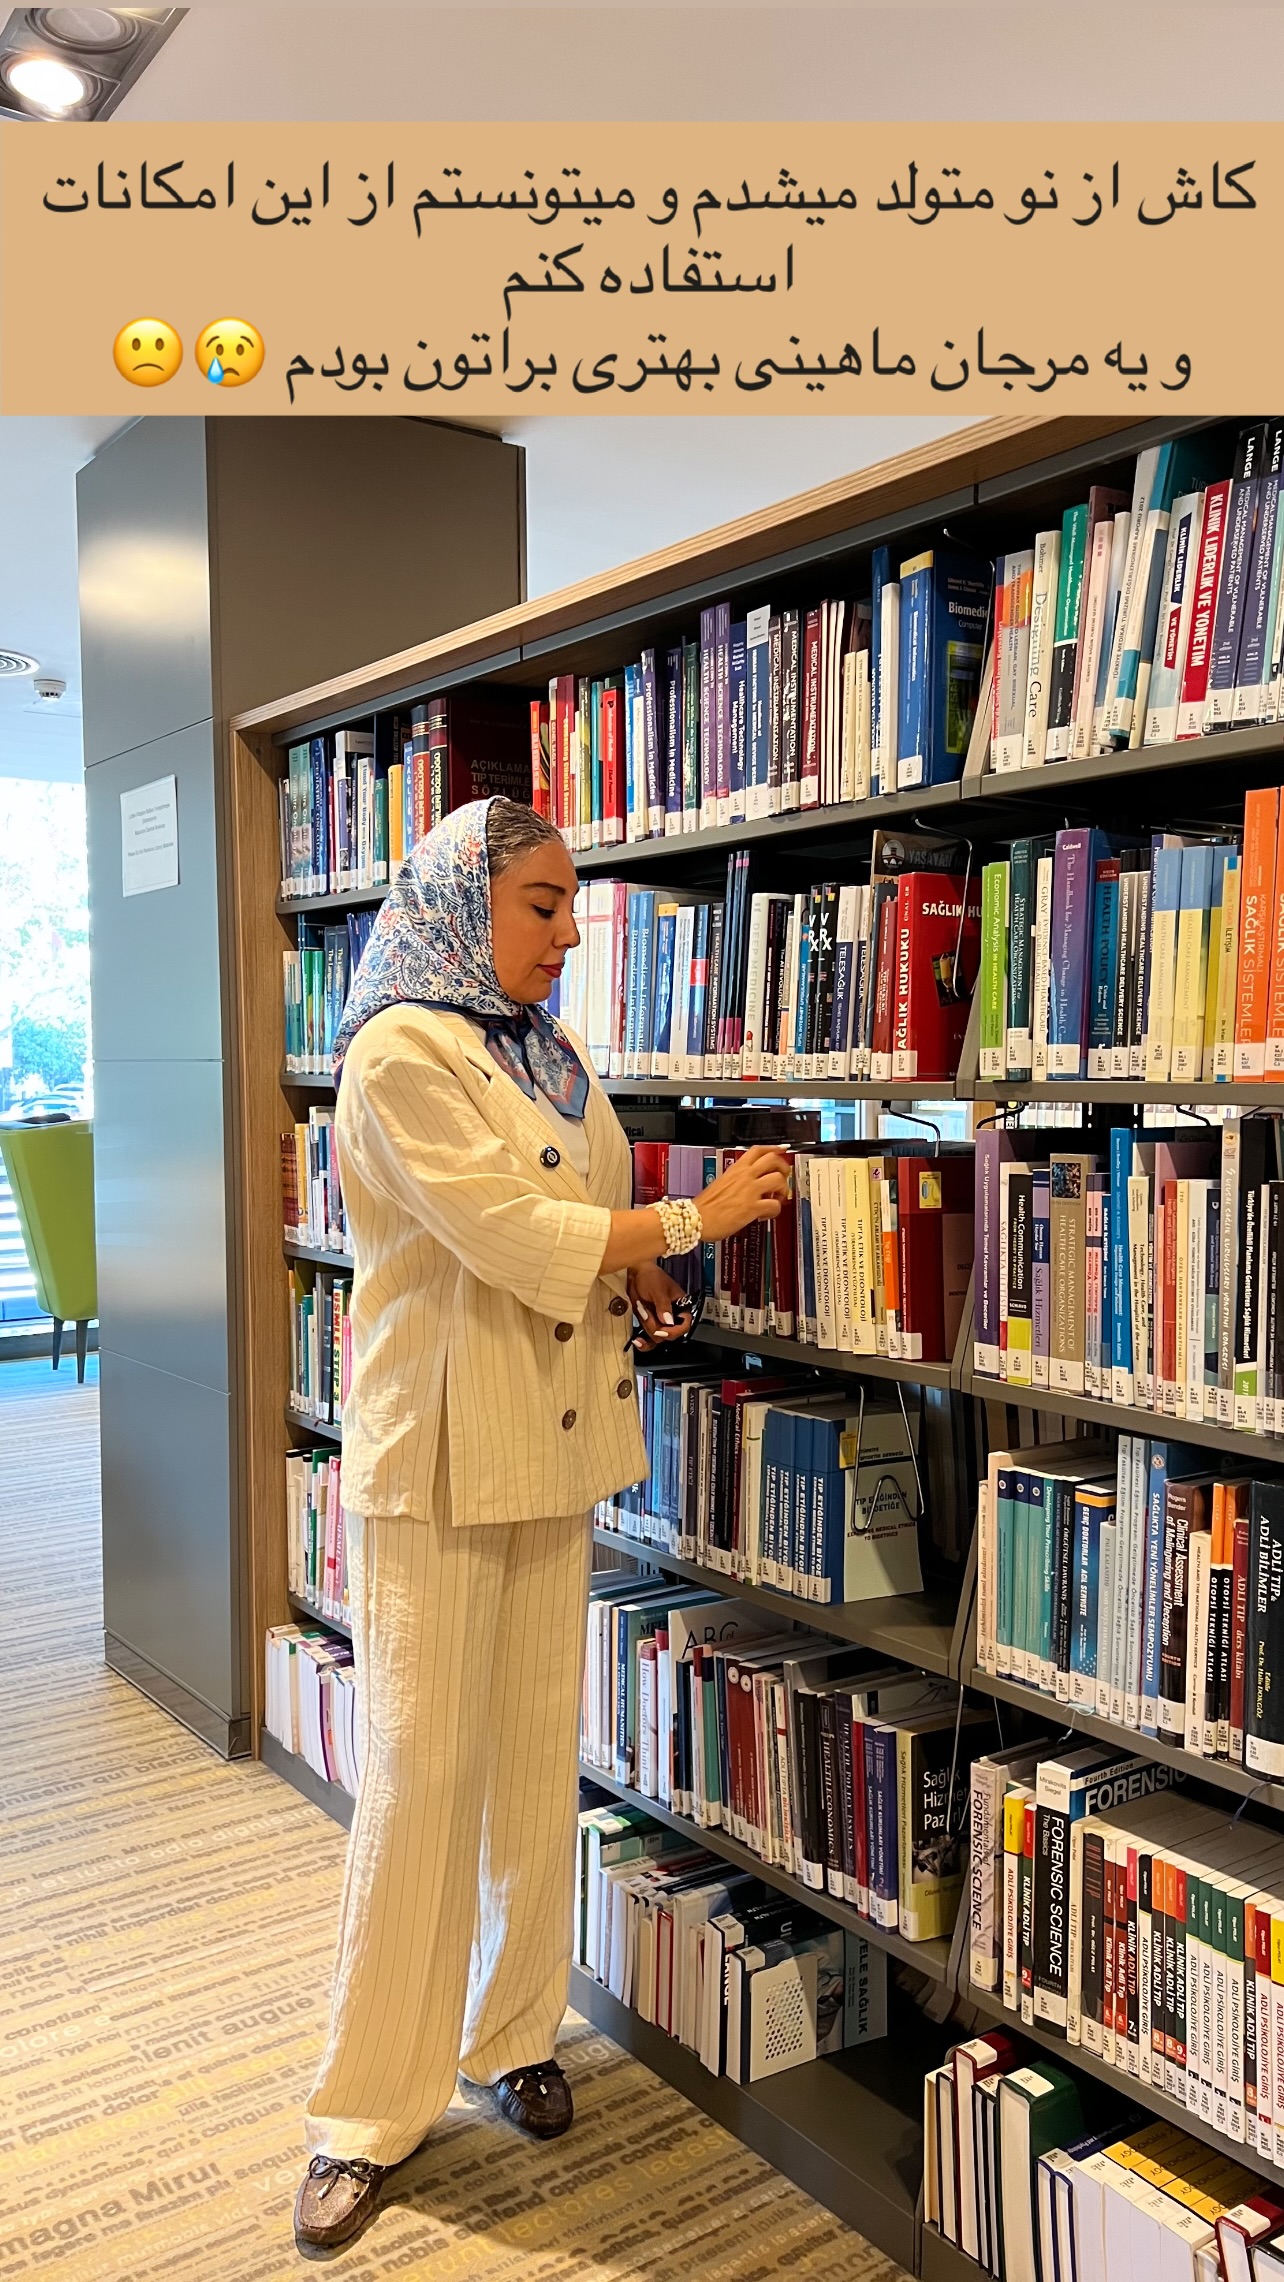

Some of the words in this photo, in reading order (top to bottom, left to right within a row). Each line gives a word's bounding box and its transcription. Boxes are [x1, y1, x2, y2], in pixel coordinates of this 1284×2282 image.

[1243, 436, 1255, 479] LANGE
[1271, 429, 1283, 473] LANGE
[1242, 486, 1251, 519] MEDICAL
[1038, 542, 1046, 573] Böhmer
[1226, 560, 1236, 595] PATIENTS
[1198, 590, 1212, 609] VE
[1029, 591, 1048, 679] Designing
[1171, 616, 1177, 627] VE
[809, 674, 817, 756] INSTRUMENTATION
[1028, 681, 1042, 718] Care
[471, 771, 487, 783] TIP
[922, 900, 963, 916] SAĞLIK
[1041, 887, 1049, 917] GRAY
[1101, 885, 1112, 936] HEALTH
[751, 922, 760, 956] DEEP
[1244, 896, 1258, 955] SAĞLIK
[837, 945, 847, 1000] TELESAĞLIK
[899, 928, 910, 997] HUKUKU
[1099, 938, 1111, 985] POLICY
[1119, 934, 1127, 975] HEALTHCARE
[748, 959, 759, 1021] MEDICINE
[897, 1002, 908, 1049] AĞLIK
[1018, 1194, 1026, 1224] Health
[1017, 1225, 1025, 1290] Communication
[1068, 1218, 1076, 1267] STRATEGIC
[1035, 1267, 1044, 1295] Sağlık
[1067, 1270, 1075, 1334] MANAGEMENT
[1034, 1298, 1043, 1347] Hizmetleri
[1058, 1275, 1066, 1353] ORGANIZATIONS
[1082, 1506, 1090, 1527] GENÇ
[1151, 1492, 1160, 1536] SAĞLIKTA
[1166, 1516, 1173, 1526] of
[1176, 1518, 1188, 1553] Clinical
[1259, 1515, 1270, 1552] ADLİ
[1080, 1530, 1089, 1565] DOKTORLAR
[1163, 1527, 1172, 1579] Malingering
[1272, 1538, 1282, 1573] ADLİ
[1148, 1560, 1158, 1615] YÖNELİMLER
[1173, 1553, 1187, 1607] Assessment
[1257, 1554, 1270, 1614] BİLİMLER
[1271, 1575, 1281, 1596] TIP
[1161, 1601, 1171, 1646] Deception
[1237, 1604, 1246, 1622] TIP
[1145, 1616, 1156, 1681] SEMPOZYUMU
[1236, 1629, 1244, 1649] ders
[1235, 1650, 1244, 1680] kitabı
[92, 1768, 130, 1786] qui
[823, 1741, 831, 1786] HEALTH
[923, 1769, 961, 1788] Sağlk
[1084, 1770, 1106, 1786] Fourth
[1106, 1762, 1134, 1777] Edition
[826, 1787, 835, 1854] ECONOMICS
[972, 1789, 983, 1865] FORENSIC
[984, 1792, 993, 1856] Fundamentals
[1042, 1832, 1050, 1856] Basics
[1050, 1816, 1064, 1900] FORENSIC
[972, 1865, 982, 1931] SCIENCE
[1023, 1875, 1032, 1911] KLİNİK
[1023, 1911, 1032, 1932] ADLİ
[1049, 1901, 1064, 1978] SCIENCE
[220, 1994, 316, 2037] augue
[858, 1977, 870, 2036] SAĞLIK
[201, 2099, 285, 2138] congue
[128, 2162, 223, 2207] Mirul
[549, 2157, 616, 2198] option
